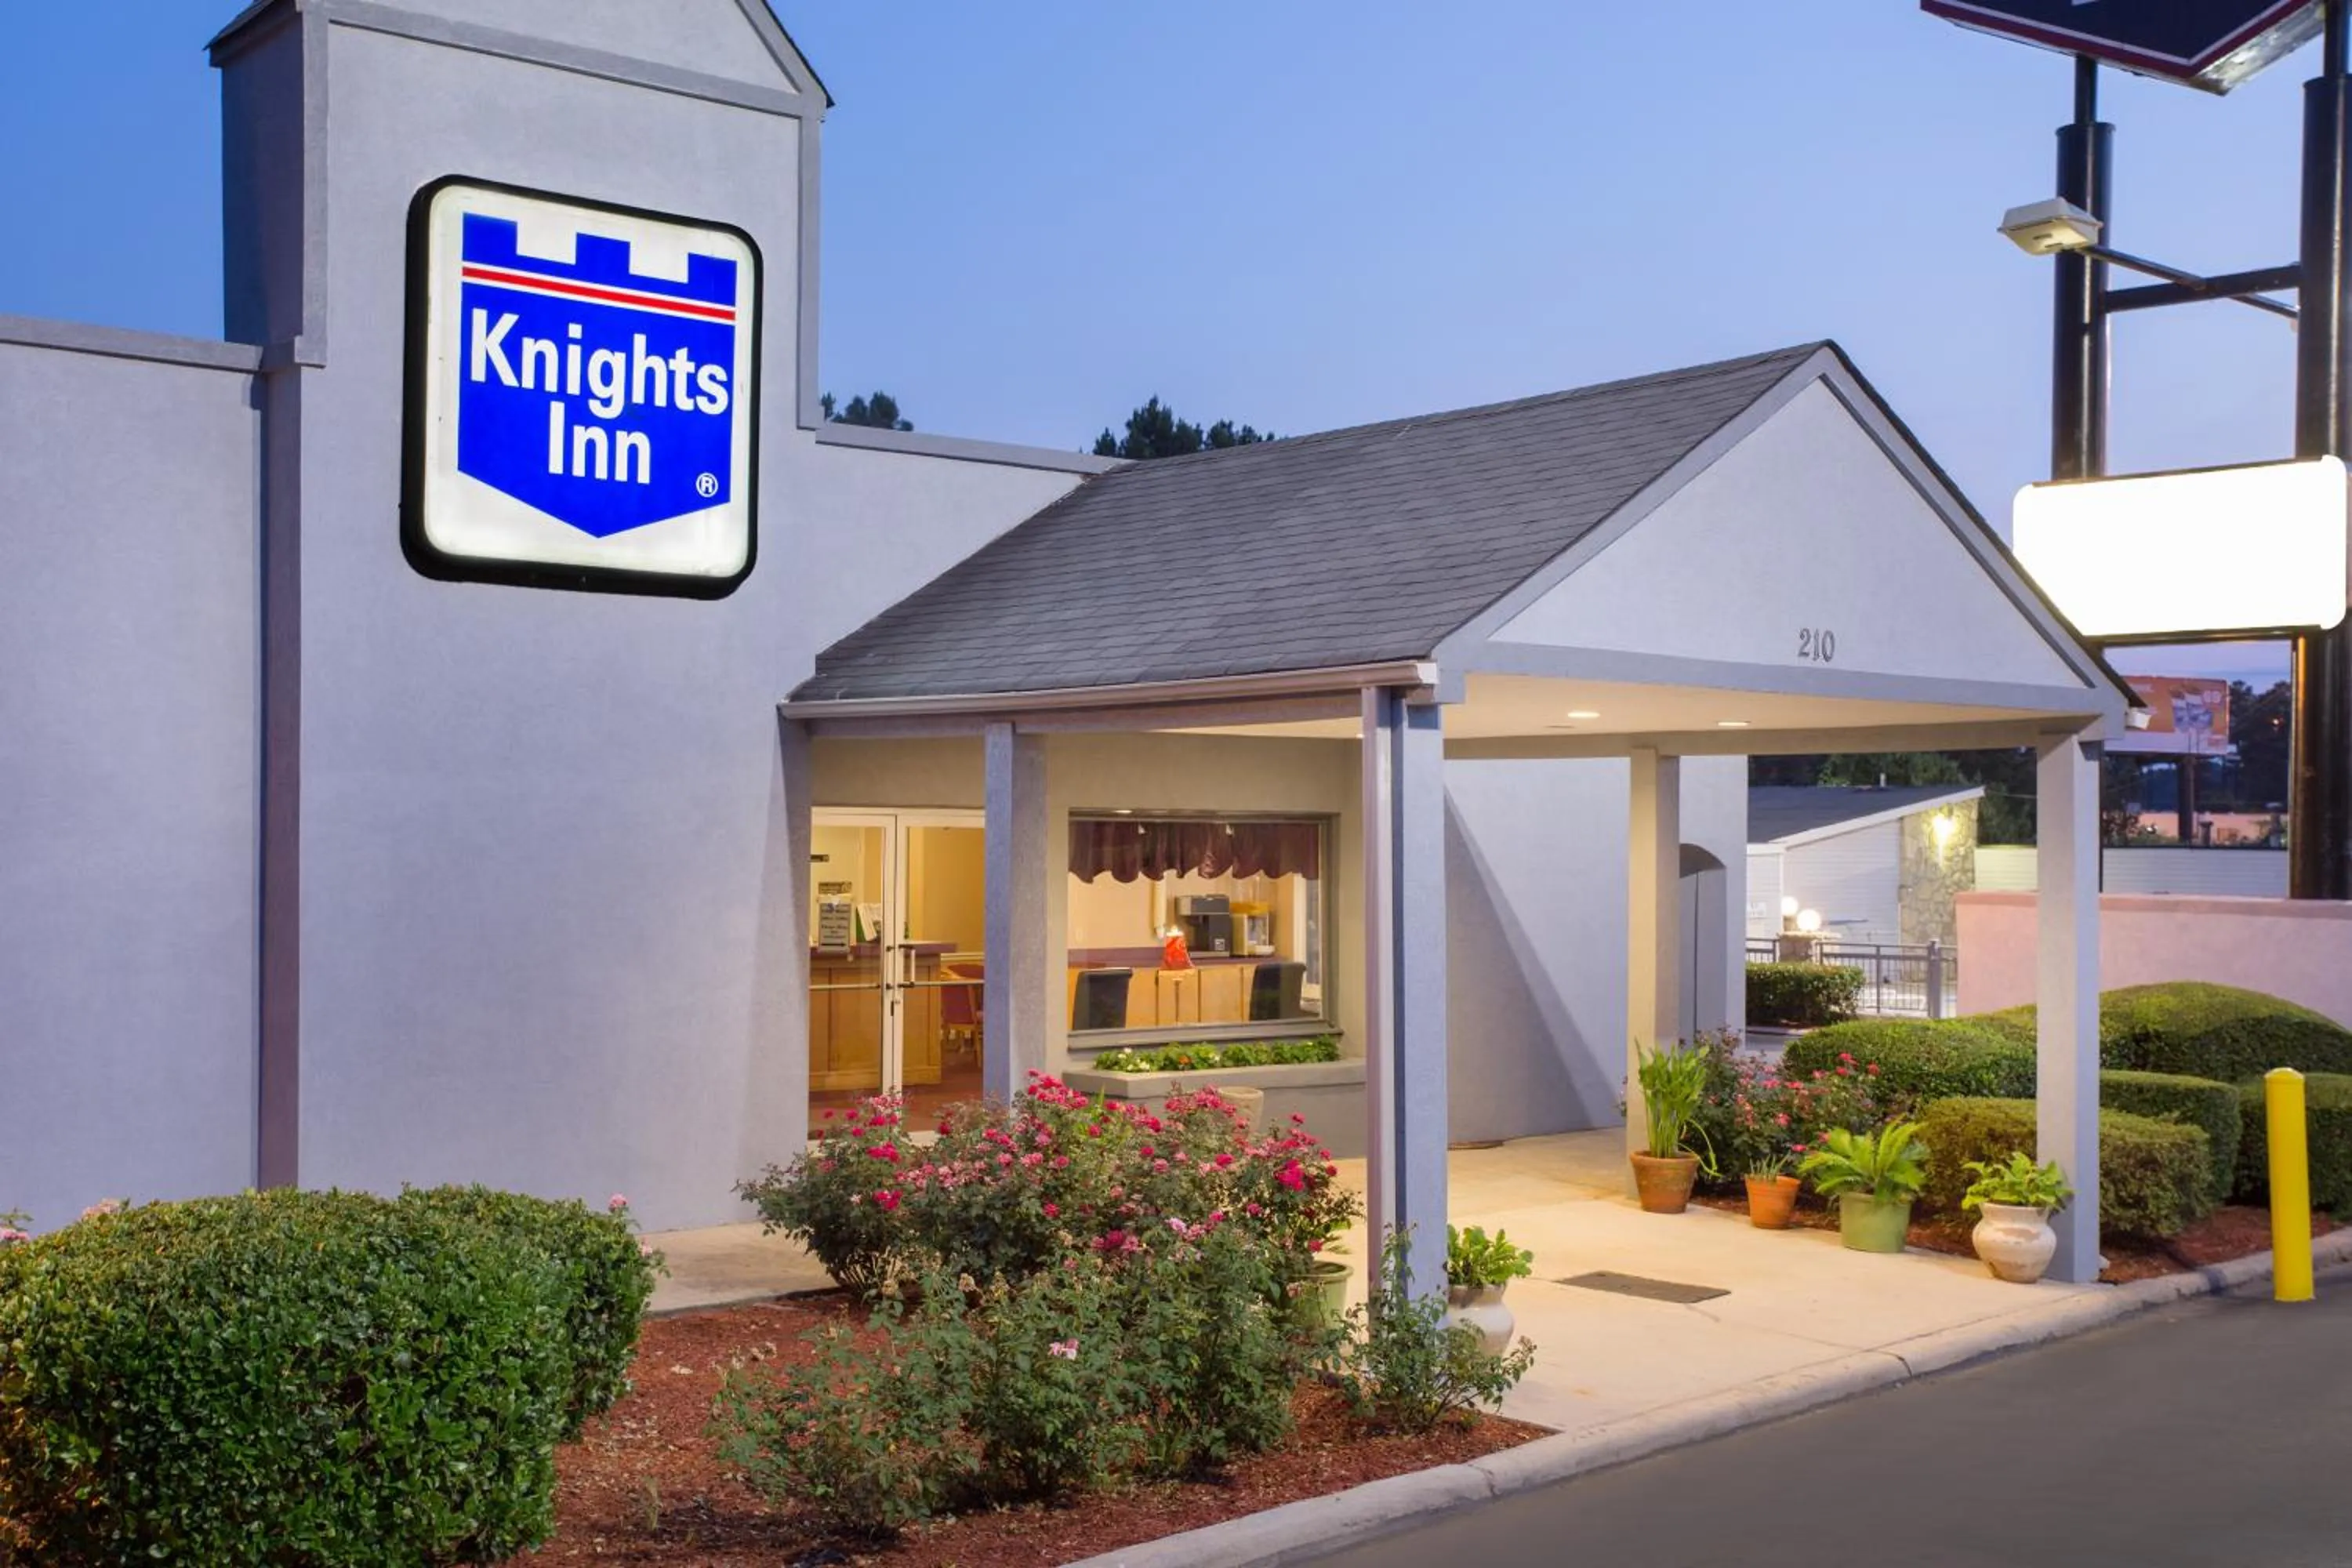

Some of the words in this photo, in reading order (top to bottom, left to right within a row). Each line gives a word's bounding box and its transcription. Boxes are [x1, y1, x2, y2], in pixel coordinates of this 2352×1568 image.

[470, 307, 728, 419] Knights
[548, 401, 651, 485] Inn
[1798, 628, 1835, 662] 210
